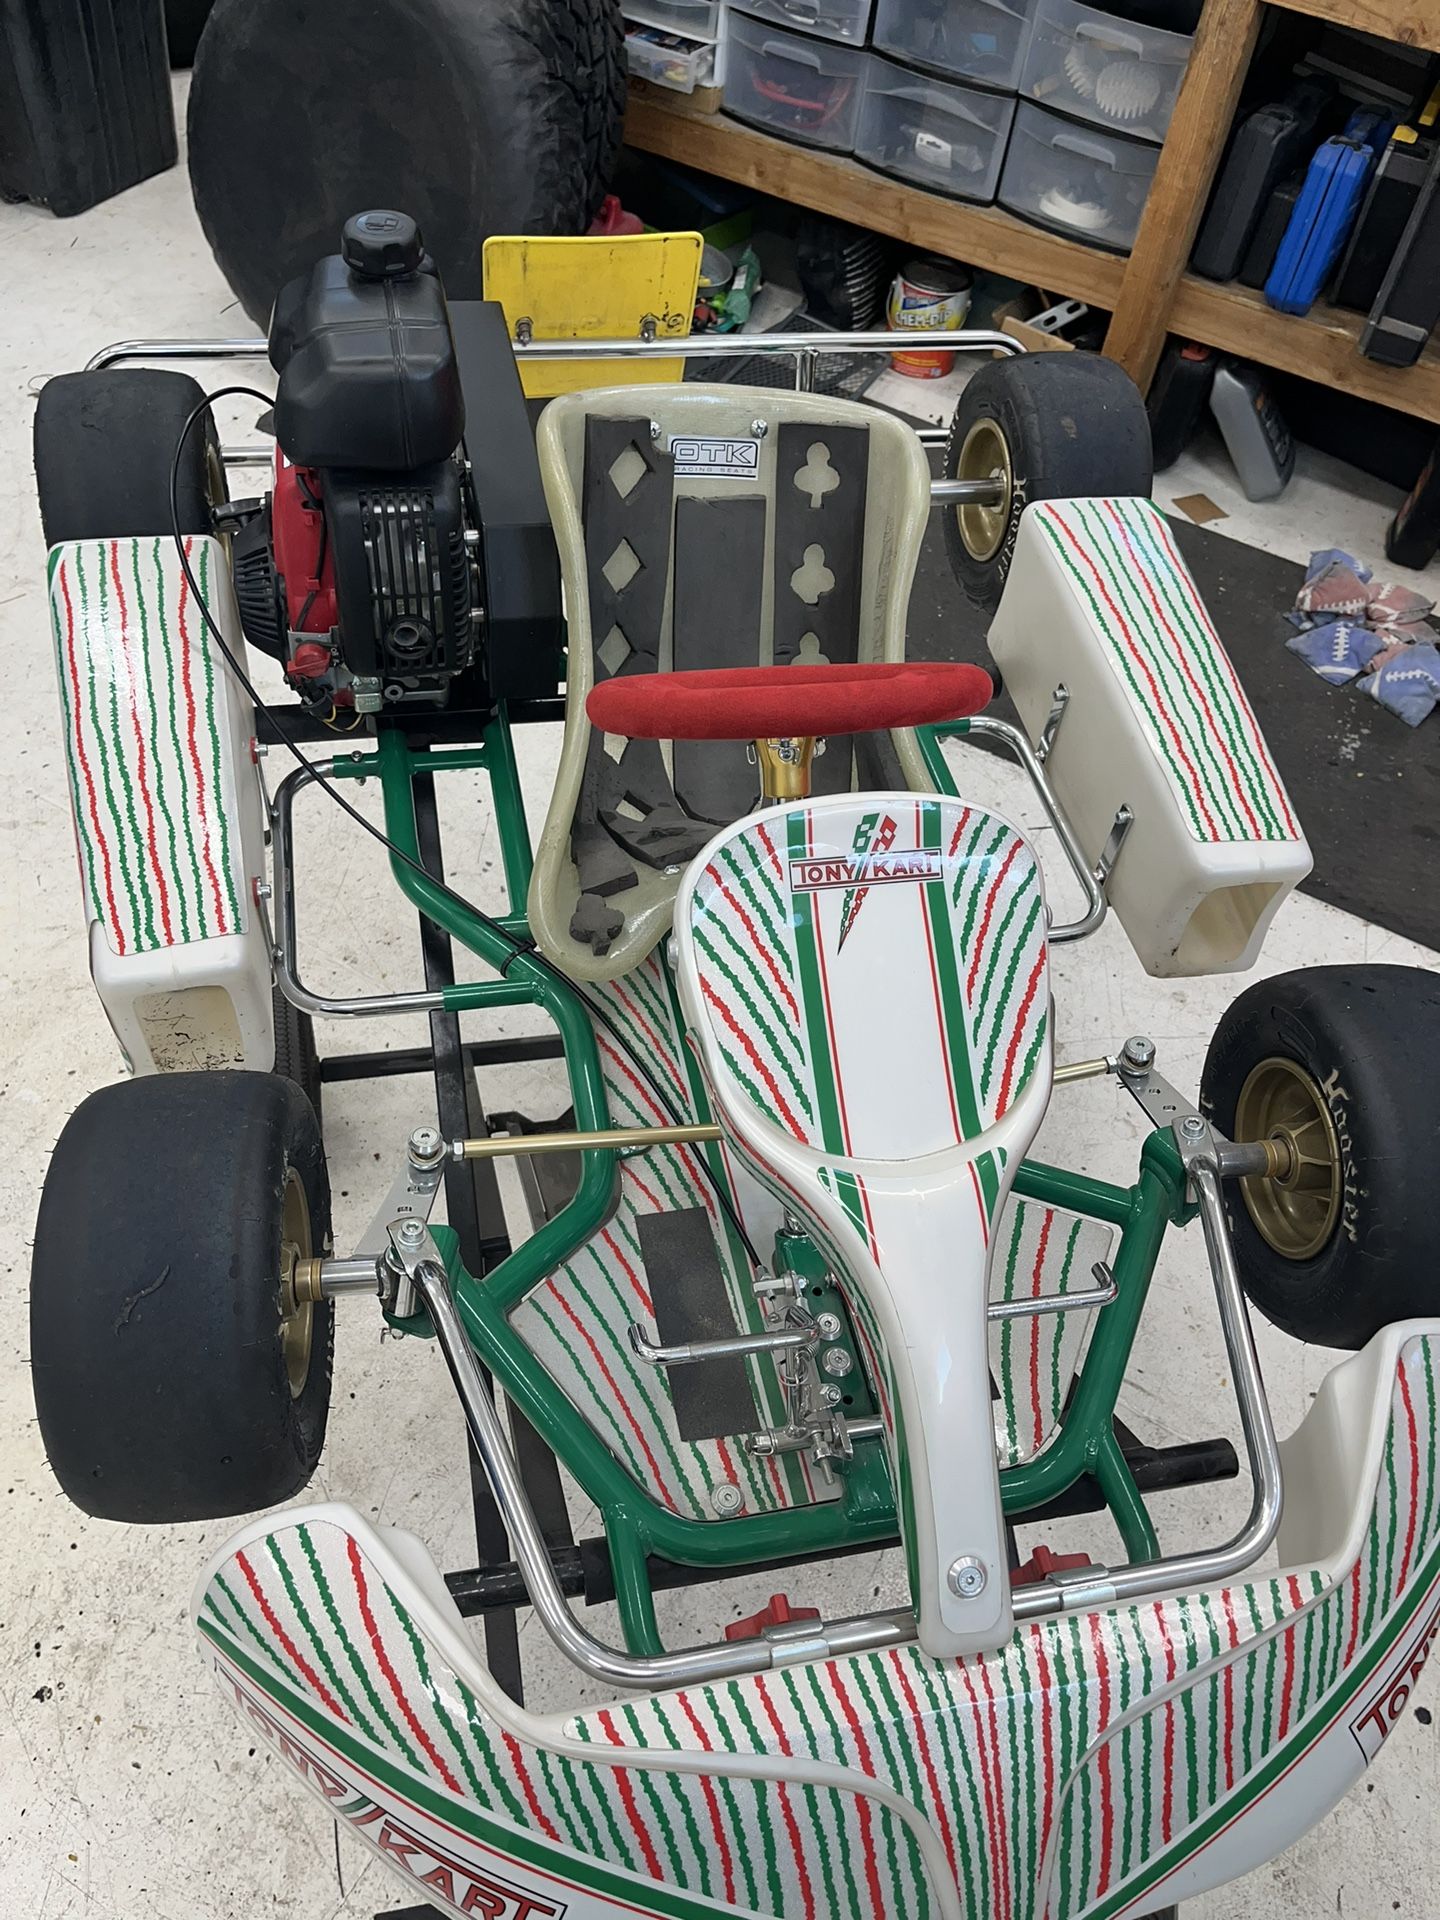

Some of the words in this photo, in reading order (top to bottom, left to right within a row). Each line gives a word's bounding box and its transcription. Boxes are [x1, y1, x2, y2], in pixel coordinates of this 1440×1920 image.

[675, 443, 753, 464] OTK
[792, 859, 857, 884] TONY
[872, 852, 937, 877] KART
